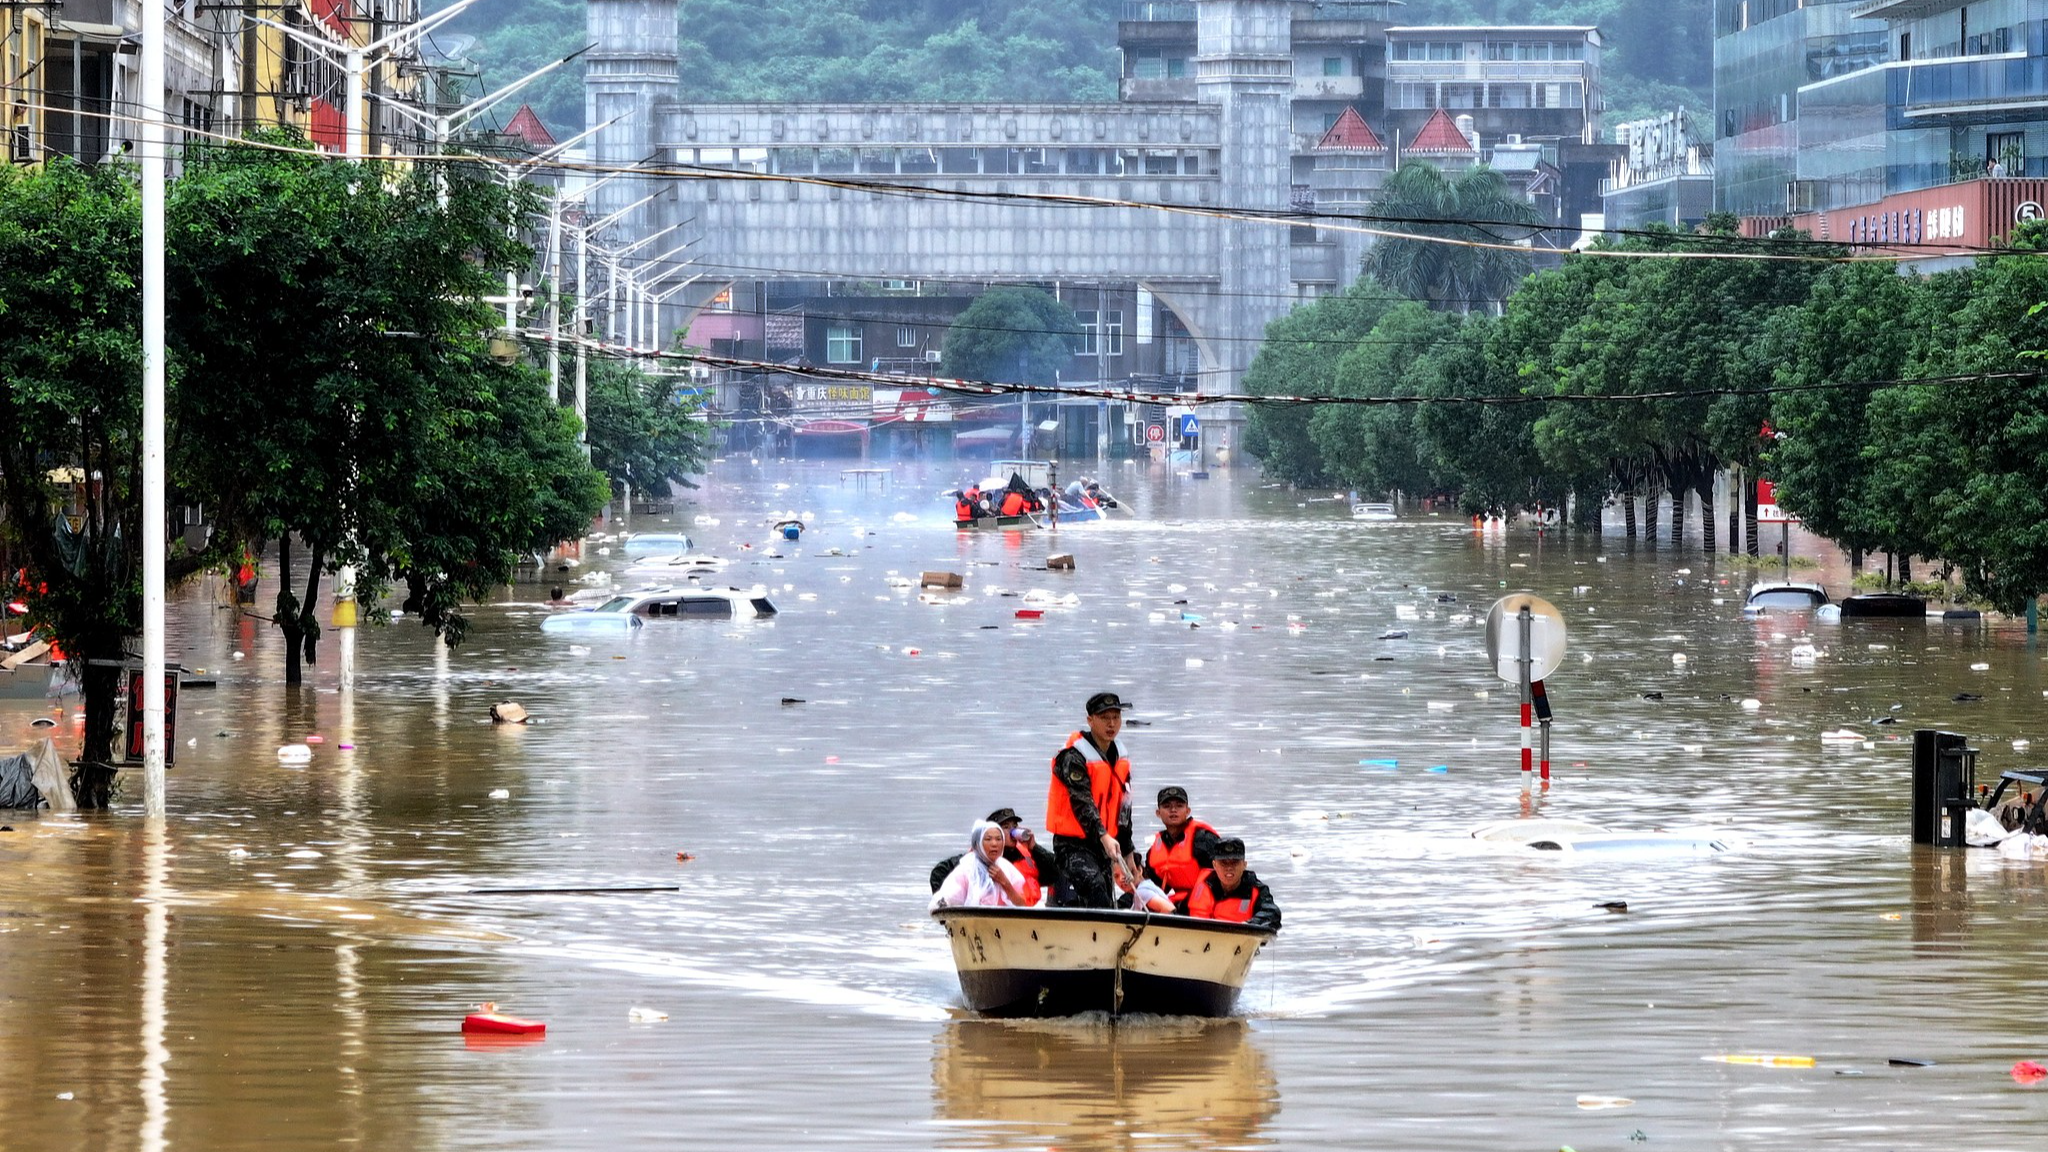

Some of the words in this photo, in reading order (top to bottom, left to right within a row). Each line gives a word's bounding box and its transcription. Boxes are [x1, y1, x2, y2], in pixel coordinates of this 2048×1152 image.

[807, 386, 870, 400] 重庆怪味面馆
[1149, 428, 1161, 440] 停
